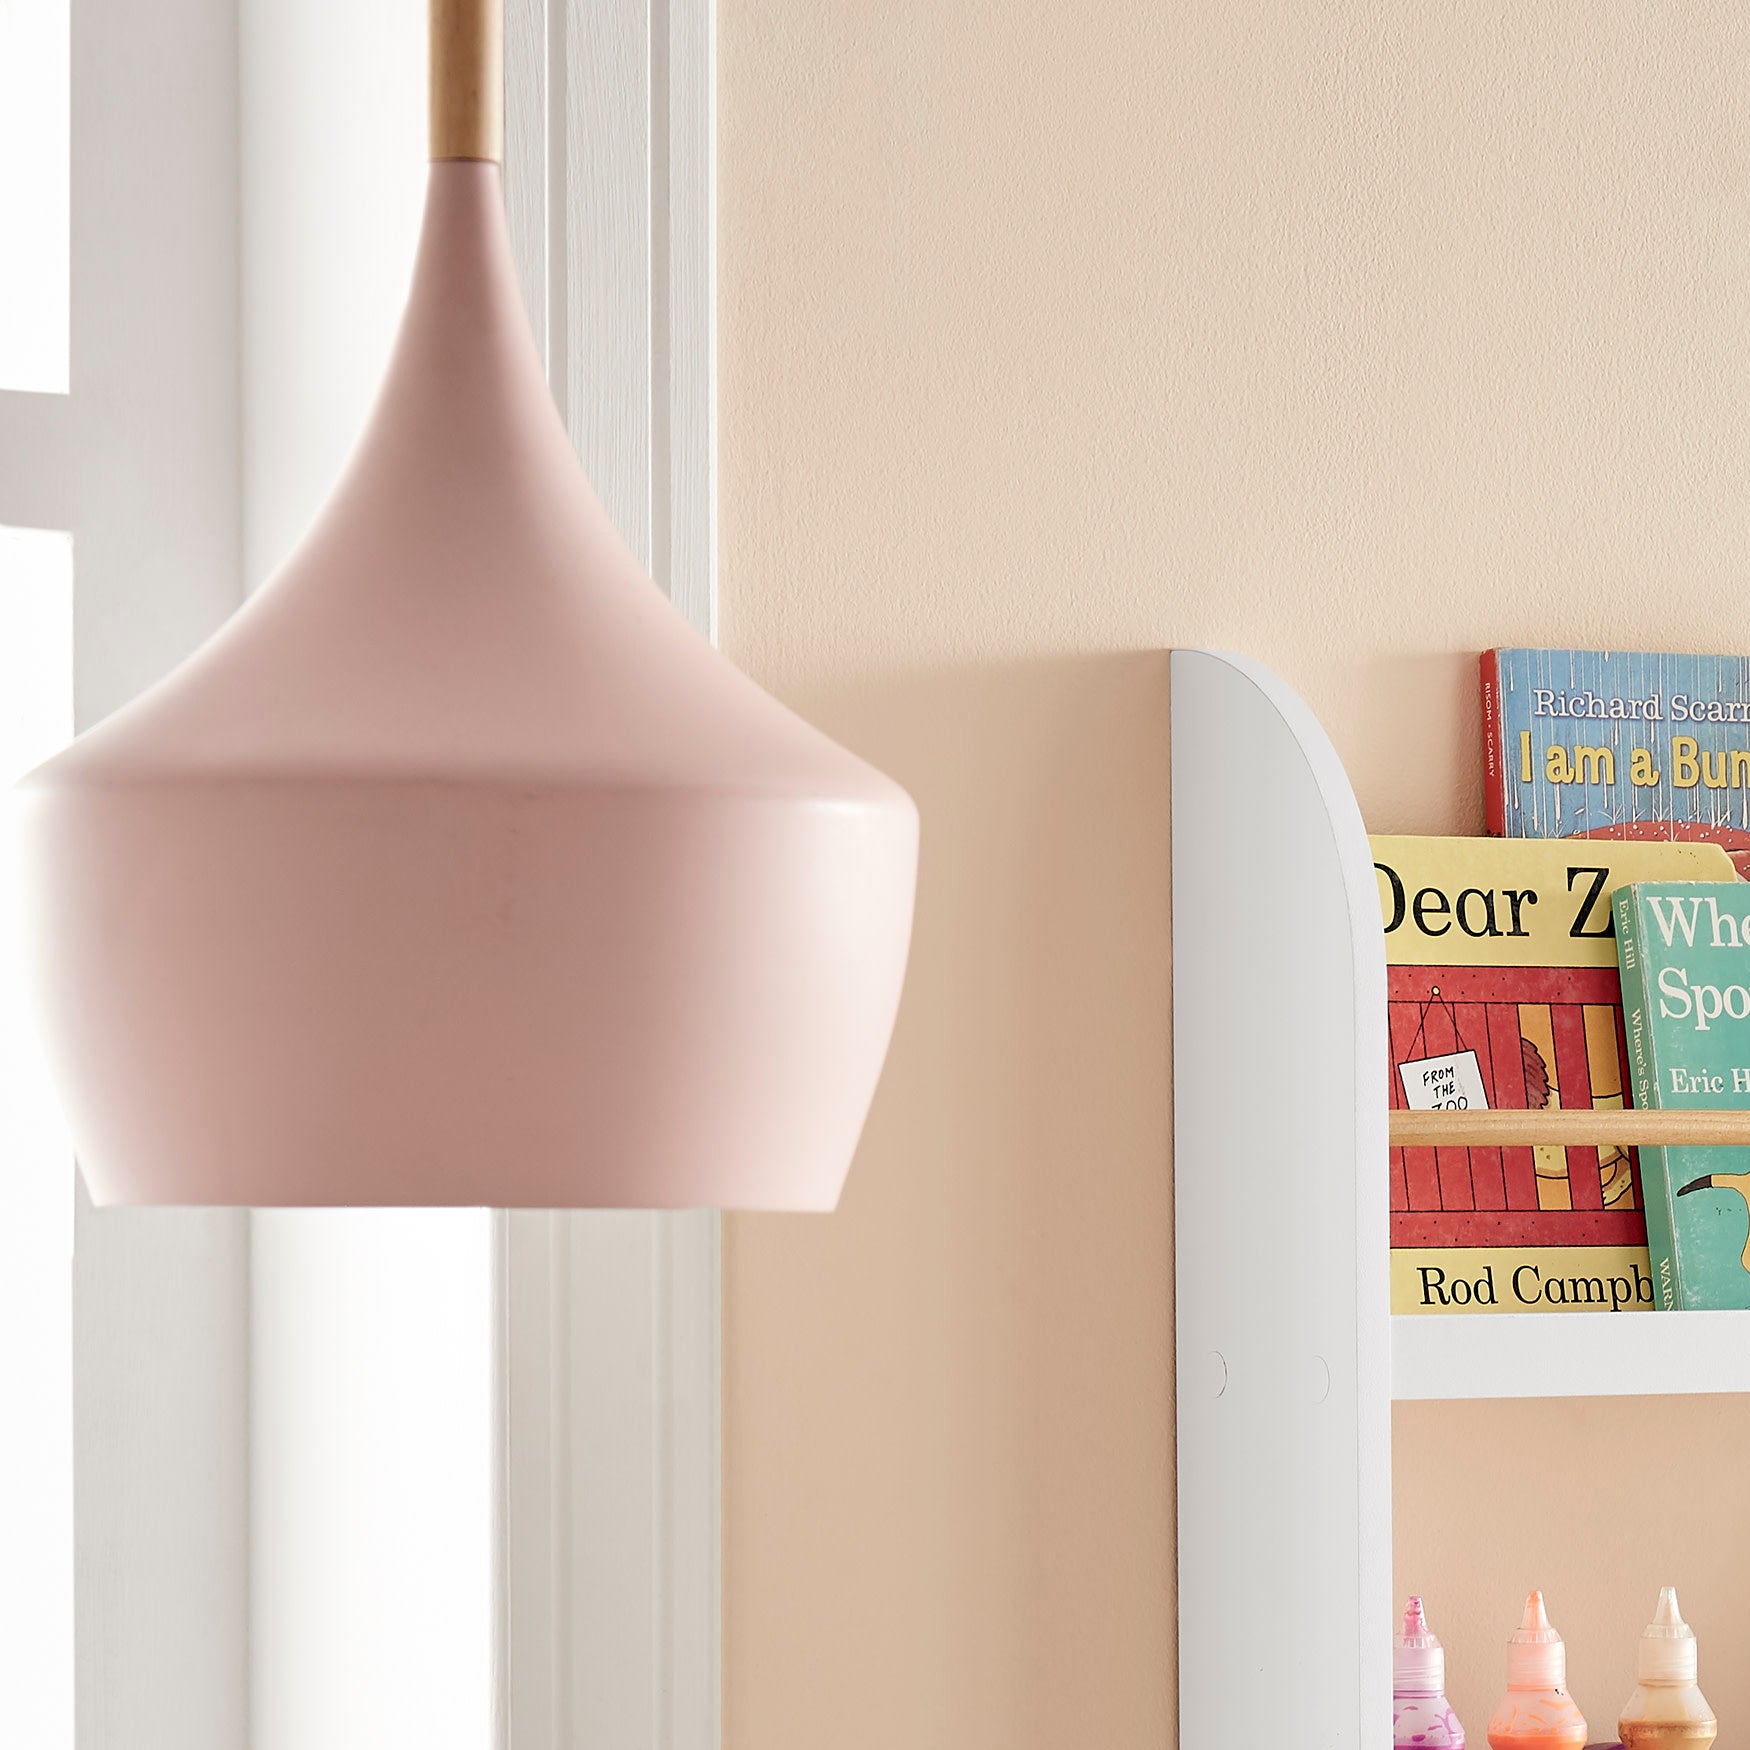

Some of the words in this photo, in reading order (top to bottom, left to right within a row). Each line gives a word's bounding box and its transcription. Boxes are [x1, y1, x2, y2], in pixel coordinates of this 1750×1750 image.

[1485, 682, 1493, 720] RISOM
[1533, 688, 1664, 721] Richard
[1487, 731, 1495, 777] SCARRY
[1519, 730, 1533, 783] I
[1545, 744, 1615, 786] am
[1629, 747, 1660, 787] a
[1619, 899, 1630, 935] Eric
[1624, 938, 1636, 970] Hill
[1631, 1008, 1648, 1076] Where's
[1422, 1066, 1455, 1087] FROM
[1433, 1080, 1456, 1099] THE
[1668, 1067, 1724, 1094] Eric
[1416, 1265, 1499, 1306] Rod
